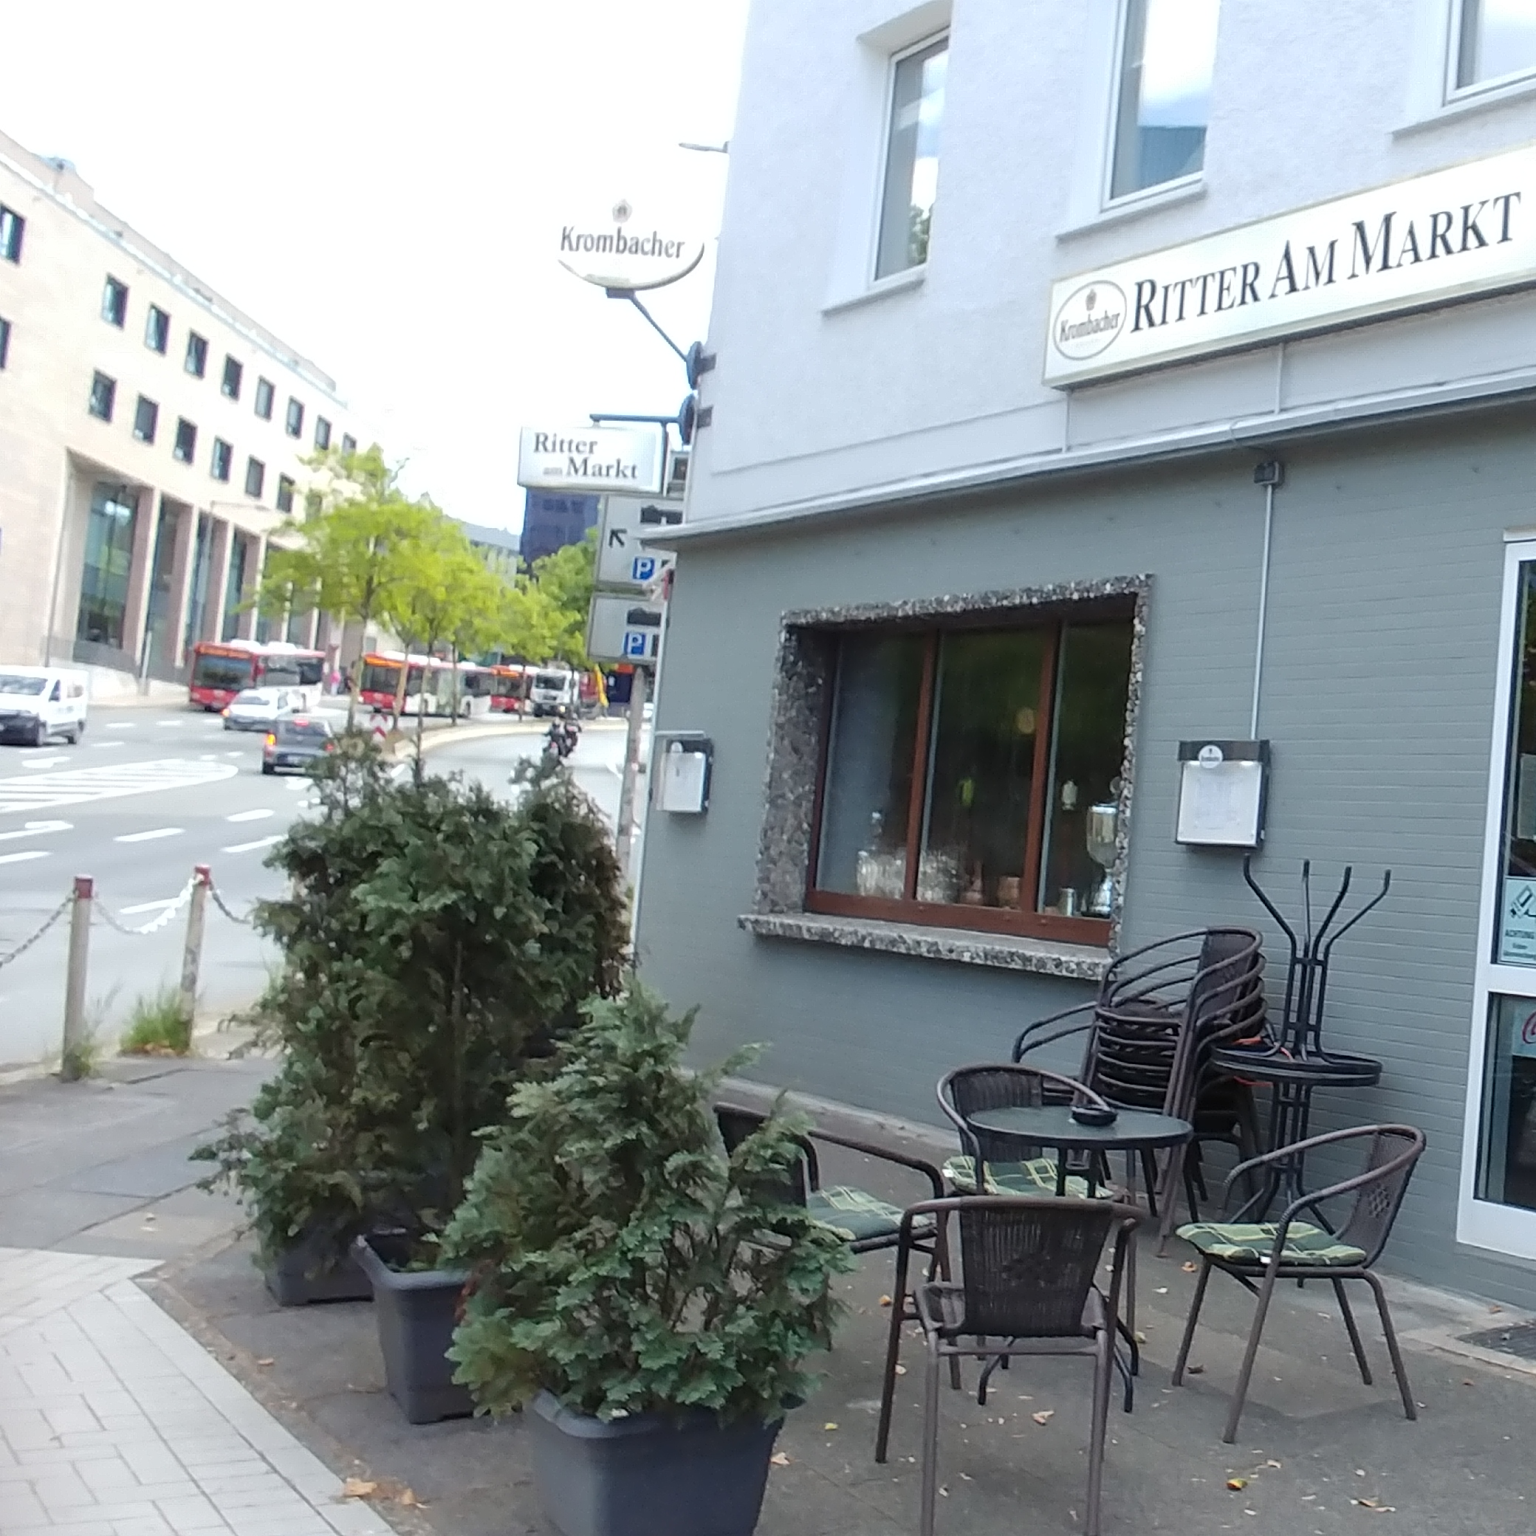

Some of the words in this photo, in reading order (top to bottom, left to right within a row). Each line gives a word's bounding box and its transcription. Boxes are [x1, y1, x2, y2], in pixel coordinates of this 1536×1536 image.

[560, 225, 686, 259] Krombacher
[1130, 261, 1261, 333] RITTER
[1268, 239, 1338, 299] AM
[1347, 191, 1521, 280] MARKT
[1059, 310, 1120, 343] Krombacher
[533, 432, 598, 455] Ritter
[566, 456, 637, 479] Markt
